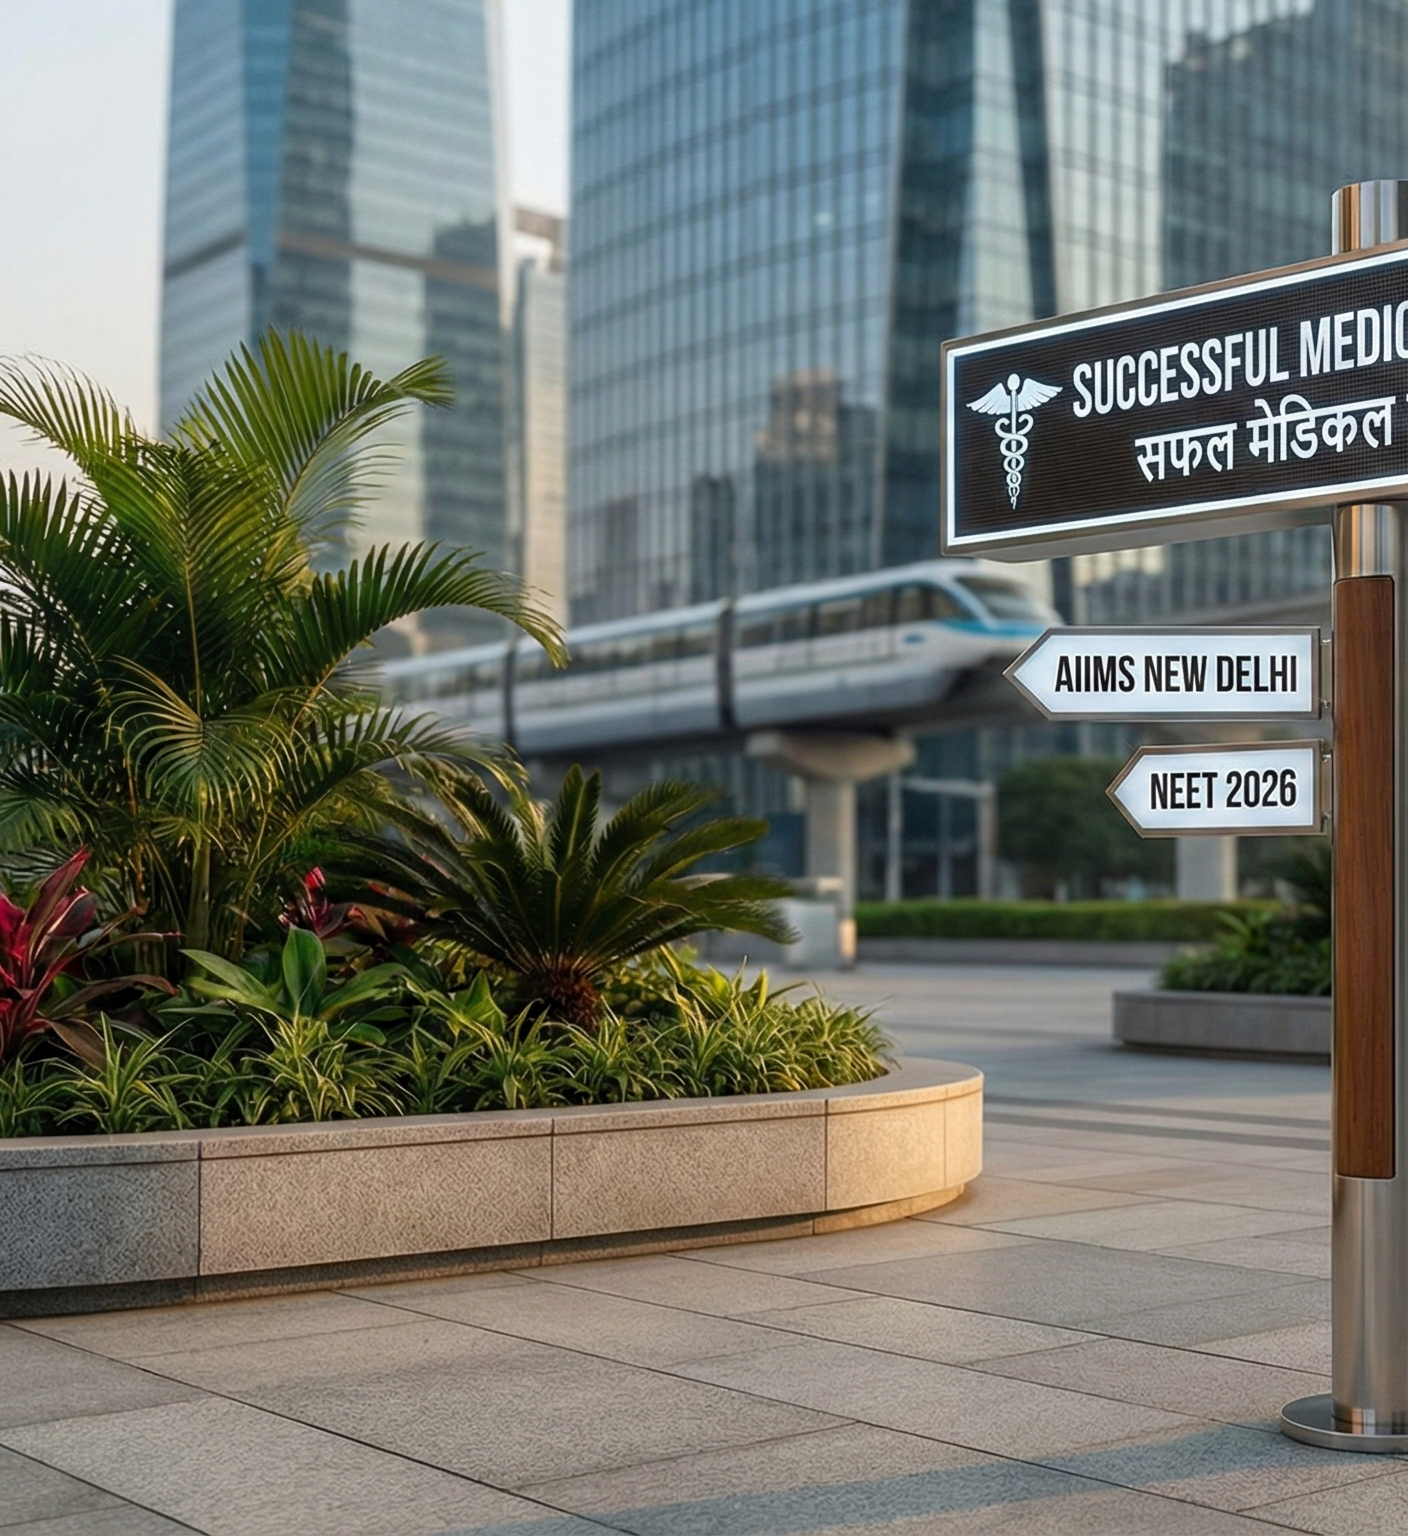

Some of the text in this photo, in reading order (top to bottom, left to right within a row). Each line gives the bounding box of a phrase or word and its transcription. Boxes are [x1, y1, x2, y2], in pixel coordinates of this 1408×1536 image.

[1072, 326, 1290, 418] SUCCESSFUL
[1134, 421, 1238, 483] सफल
[1245, 393, 1397, 463] मेडिकल
[1054, 655, 1297, 693] AIIMS NEW DELHI
[1150, 768, 1297, 810] NEET 2026
